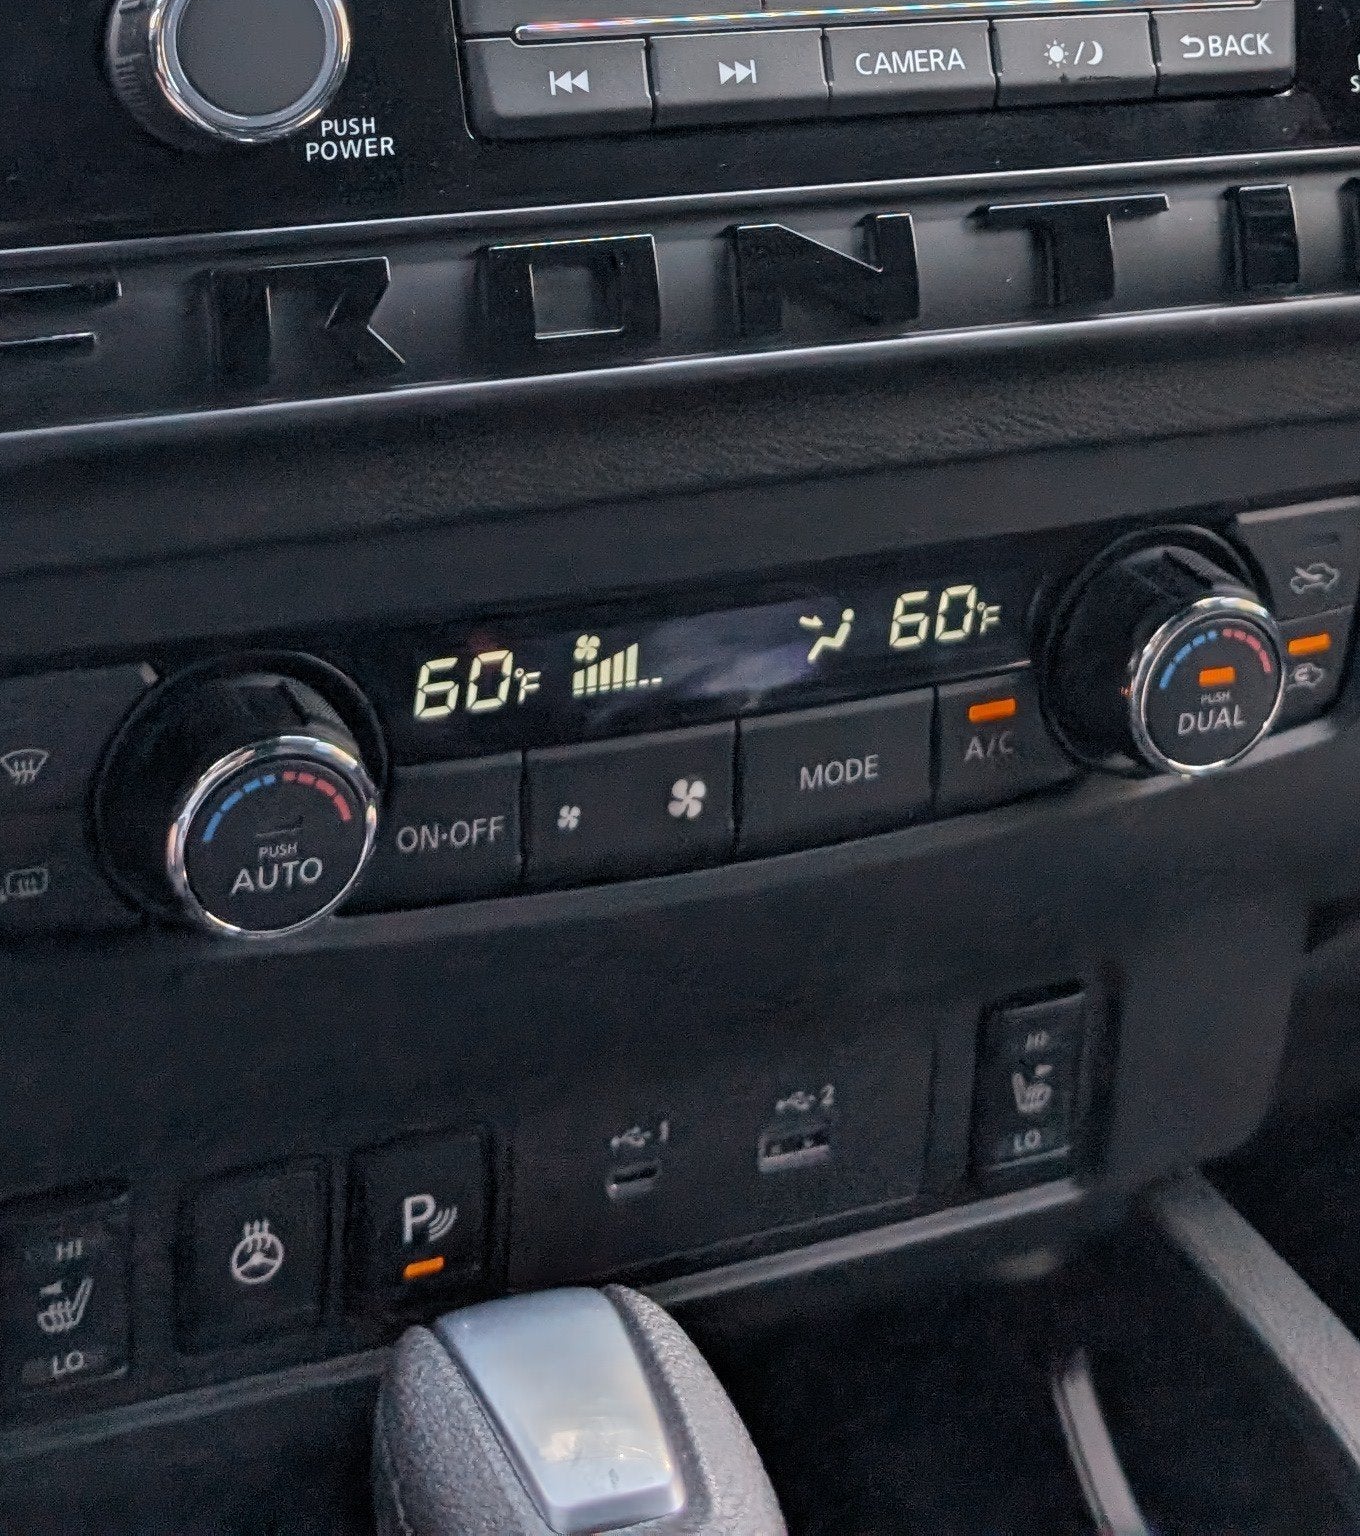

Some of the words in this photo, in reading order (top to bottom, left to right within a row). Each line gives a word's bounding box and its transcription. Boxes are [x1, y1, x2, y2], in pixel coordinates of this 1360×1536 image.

[1208, 32, 1273, 58] BACK
[854, 48, 966, 76] CAMERA
[320, 117, 377, 138] PUSH
[306, 137, 395, 160] POWER
[1201, 692, 1230, 704] PUSH
[1177, 705, 1246, 736] DUAL
[965, 732, 1015, 763] A/C
[799, 753, 881, 792] MODE
[258, 842, 298, 857] PUSH
[231, 857, 323, 896] AUTO
[1013, 1129, 1041, 1154] LO
[403, 1195, 434, 1244] P
[54, 1240, 83, 1261] HI
[52, 1350, 85, 1377] LO
